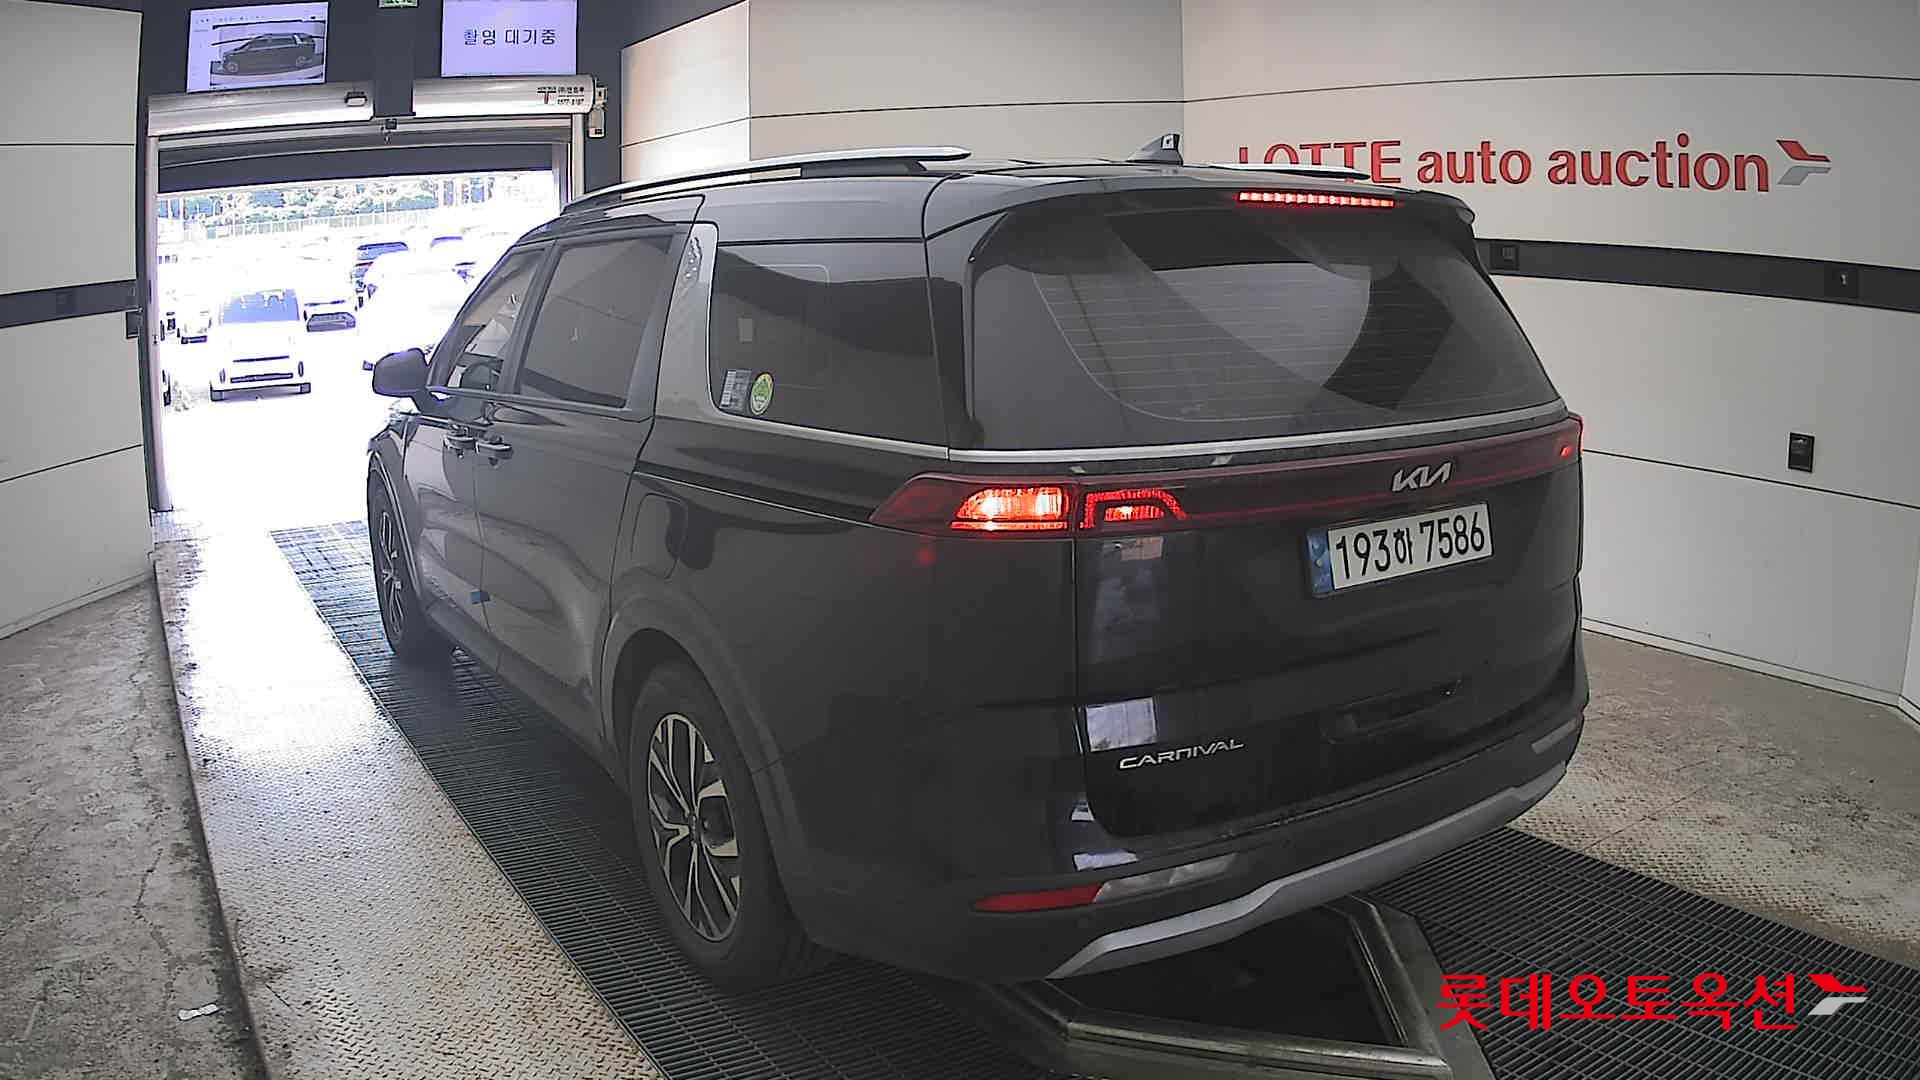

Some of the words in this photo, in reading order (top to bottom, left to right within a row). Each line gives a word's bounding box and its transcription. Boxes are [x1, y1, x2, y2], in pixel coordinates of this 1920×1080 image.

[504, 28, 556, 46] 대기중
[1416, 140, 1532, 185] auto
[1547, 132, 1770, 193] auction
[1391, 462, 1453, 492] KIA
[1335, 526, 1413, 580] 193하
[1419, 511, 1486, 563] 7586
[1118, 738, 1245, 770] CARNIVAL
